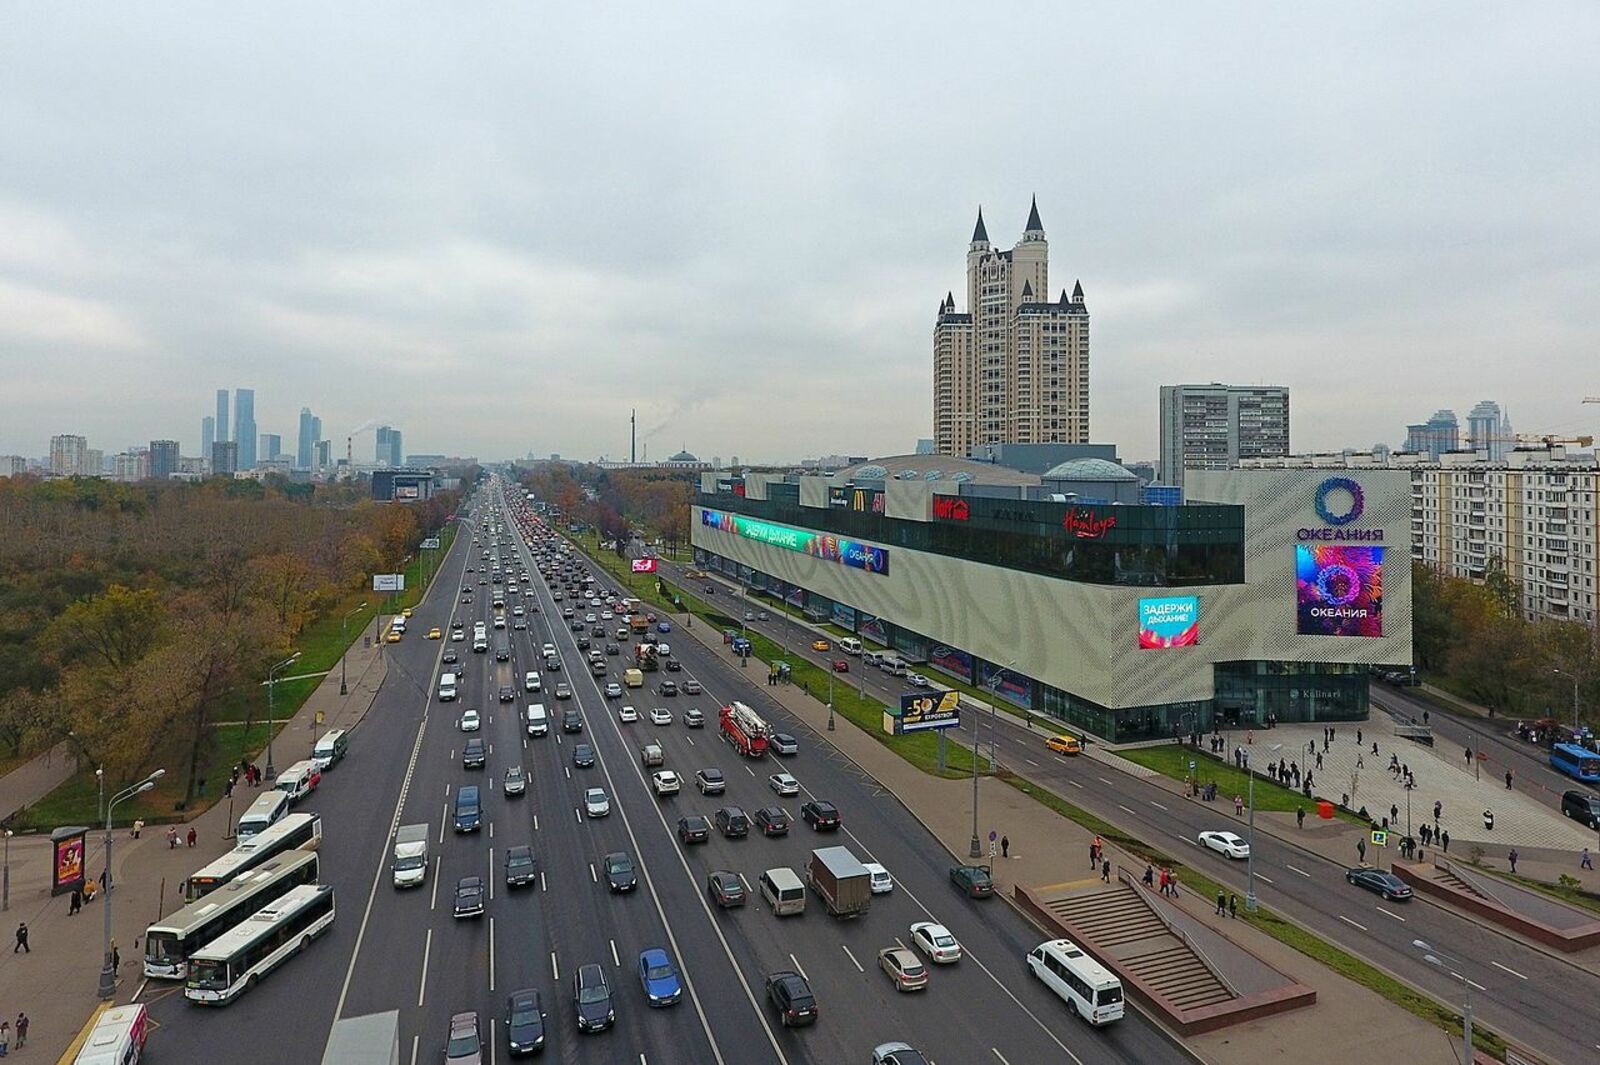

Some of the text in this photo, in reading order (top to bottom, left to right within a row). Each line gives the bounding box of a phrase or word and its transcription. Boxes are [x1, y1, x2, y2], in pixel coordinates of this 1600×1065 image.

[1063, 505, 1117, 539] Hamleys
[1297, 528, 1384, 541] ОКЕАНИЯ
[1143, 603, 1193, 616] ЗАДЕРЖИ
[1310, 607, 1368, 618] ОКЕАНИЯ
